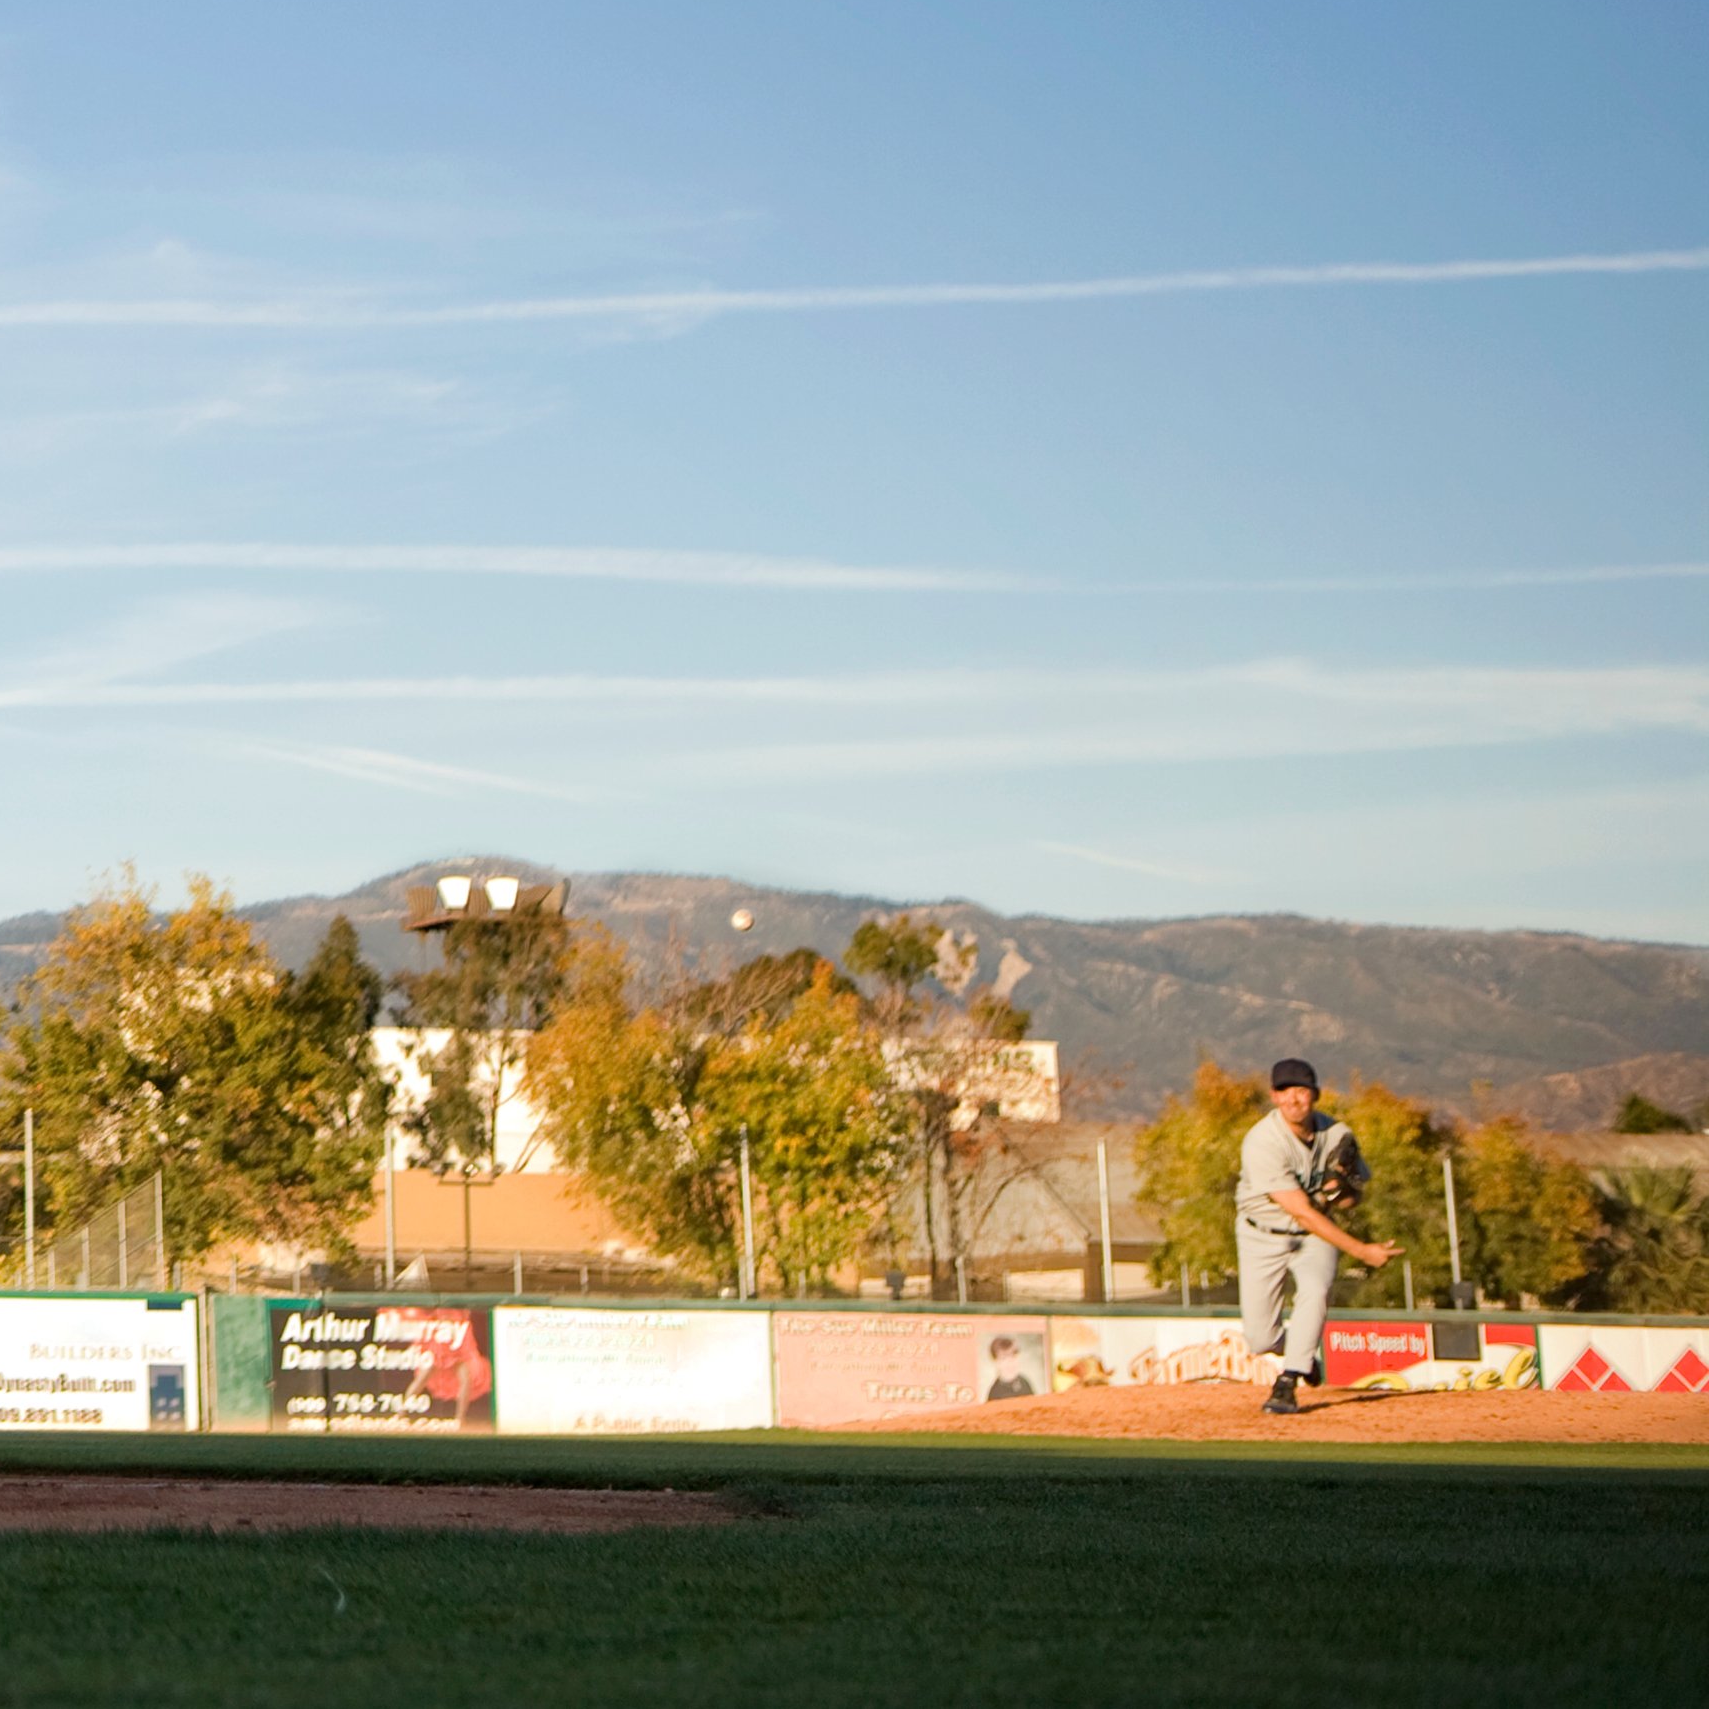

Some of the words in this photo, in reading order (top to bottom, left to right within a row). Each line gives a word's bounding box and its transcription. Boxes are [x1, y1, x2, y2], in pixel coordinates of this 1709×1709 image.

[280, 1311, 371, 1342] Arthur
[372, 1310, 470, 1351] Murray
[1330, 1331, 1365, 1352] Pitch
[1367, 1332, 1407, 1356] Speed
[1410, 1333, 1426, 1357] by
[281, 1343, 358, 1371] Dance
[359, 1343, 435, 1371] Studio
[863, 1380, 938, 1405] Turns
[944, 1382, 976, 1406] To
